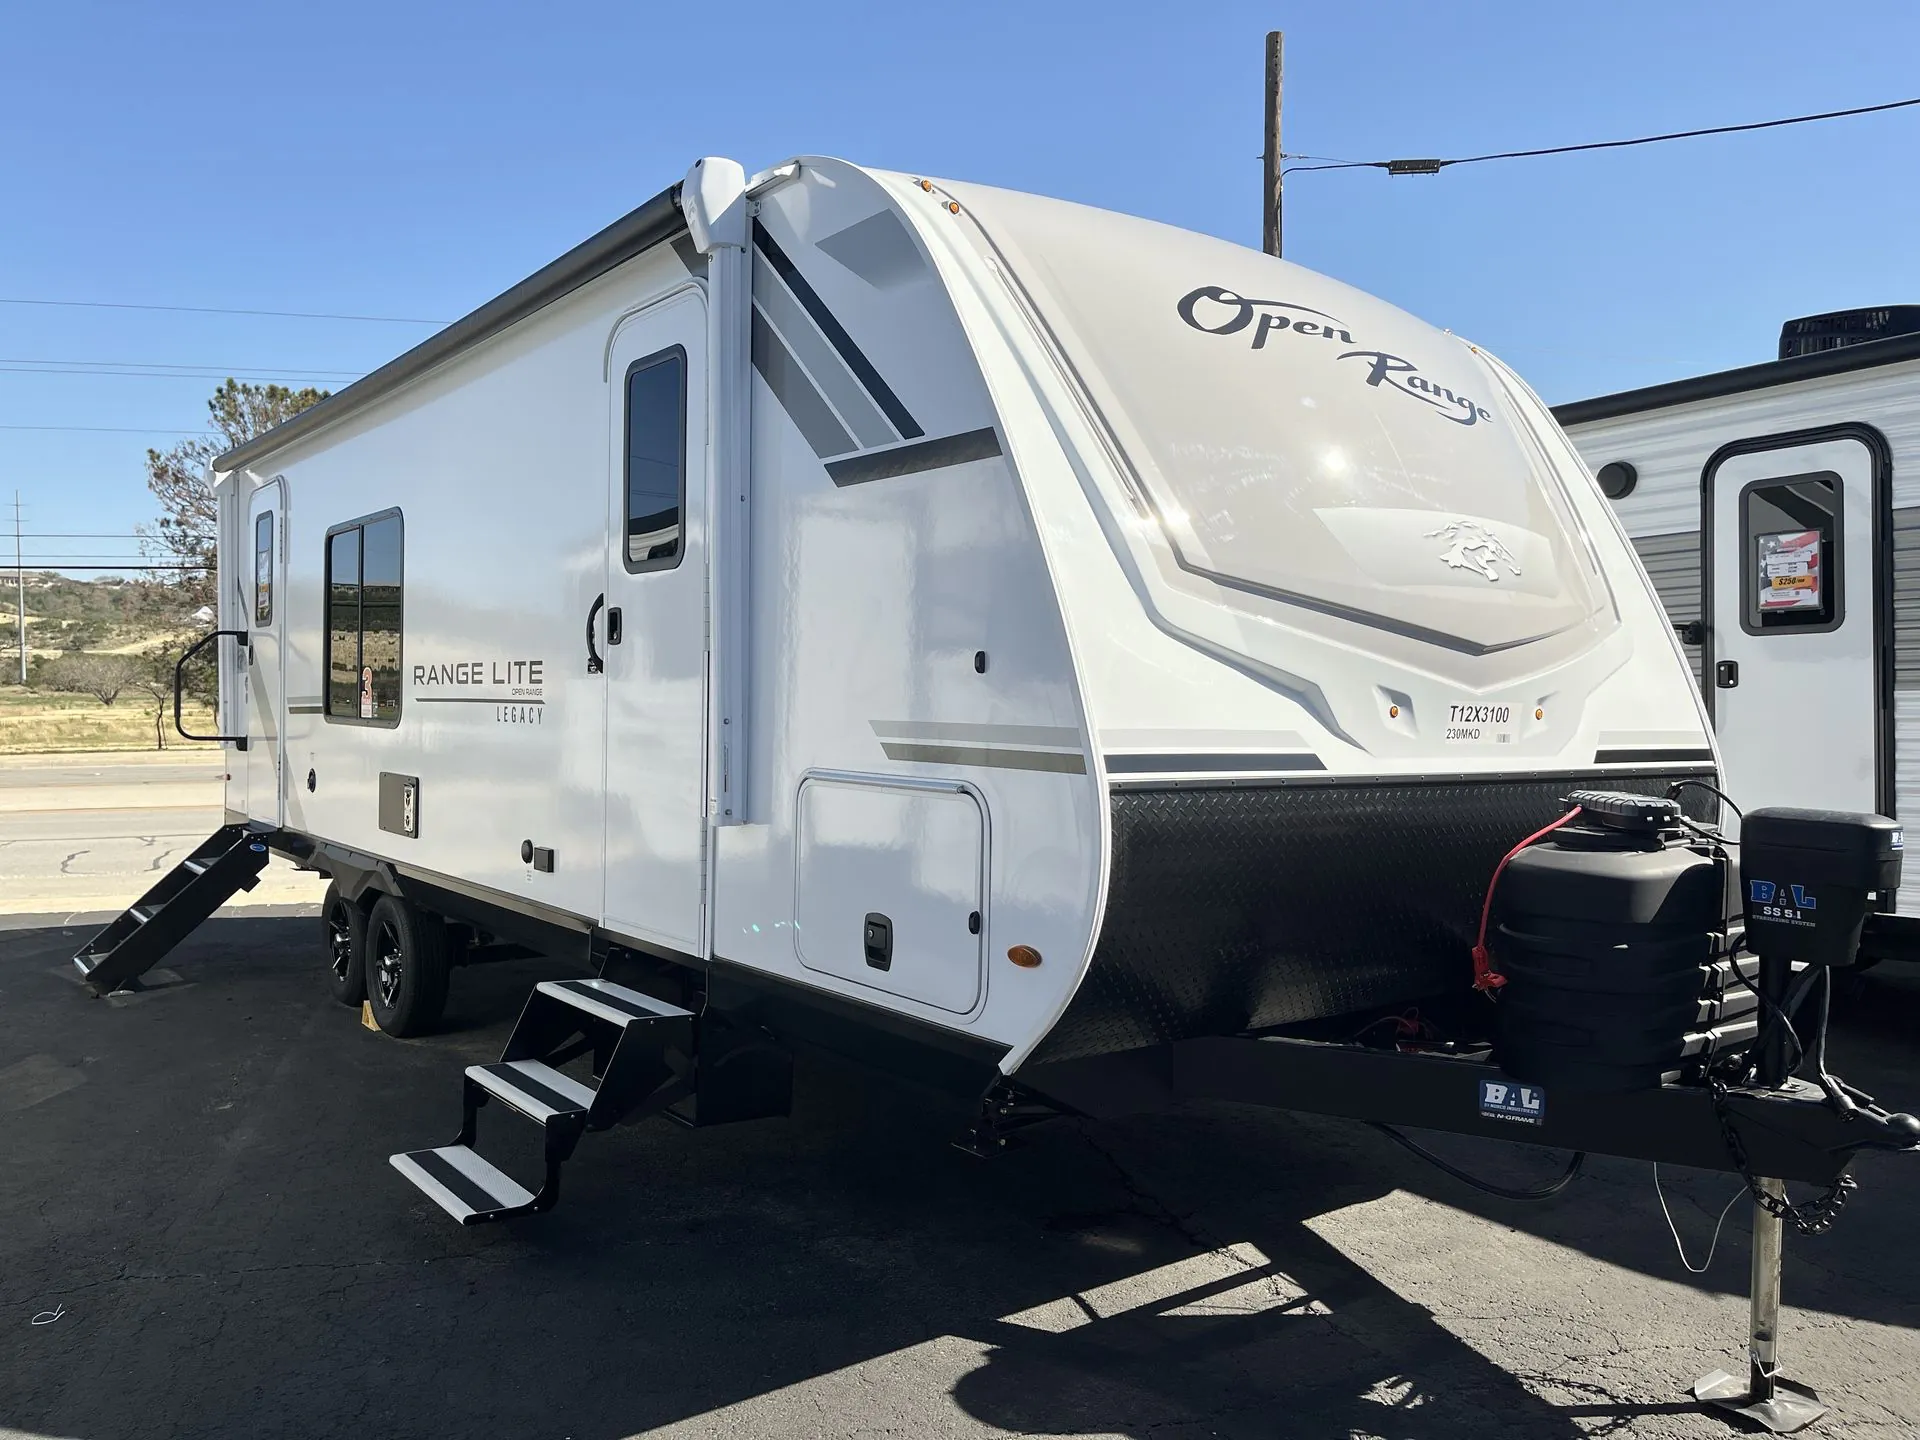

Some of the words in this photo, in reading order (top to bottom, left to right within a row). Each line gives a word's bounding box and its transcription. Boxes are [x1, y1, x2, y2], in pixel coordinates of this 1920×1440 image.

[1177, 286, 1357, 350] Open
[1336, 351, 1494, 426] Range
[413, 662, 484, 686] RANGE
[492, 660, 543, 685] LITE
[511, 688, 525, 696] OPEN
[525, 688, 543, 696] RANGE
[496, 706, 543, 724] LEGACY
[1450, 705, 1510, 723] T12X3100
[1446, 728, 1480, 740] 230MKD
